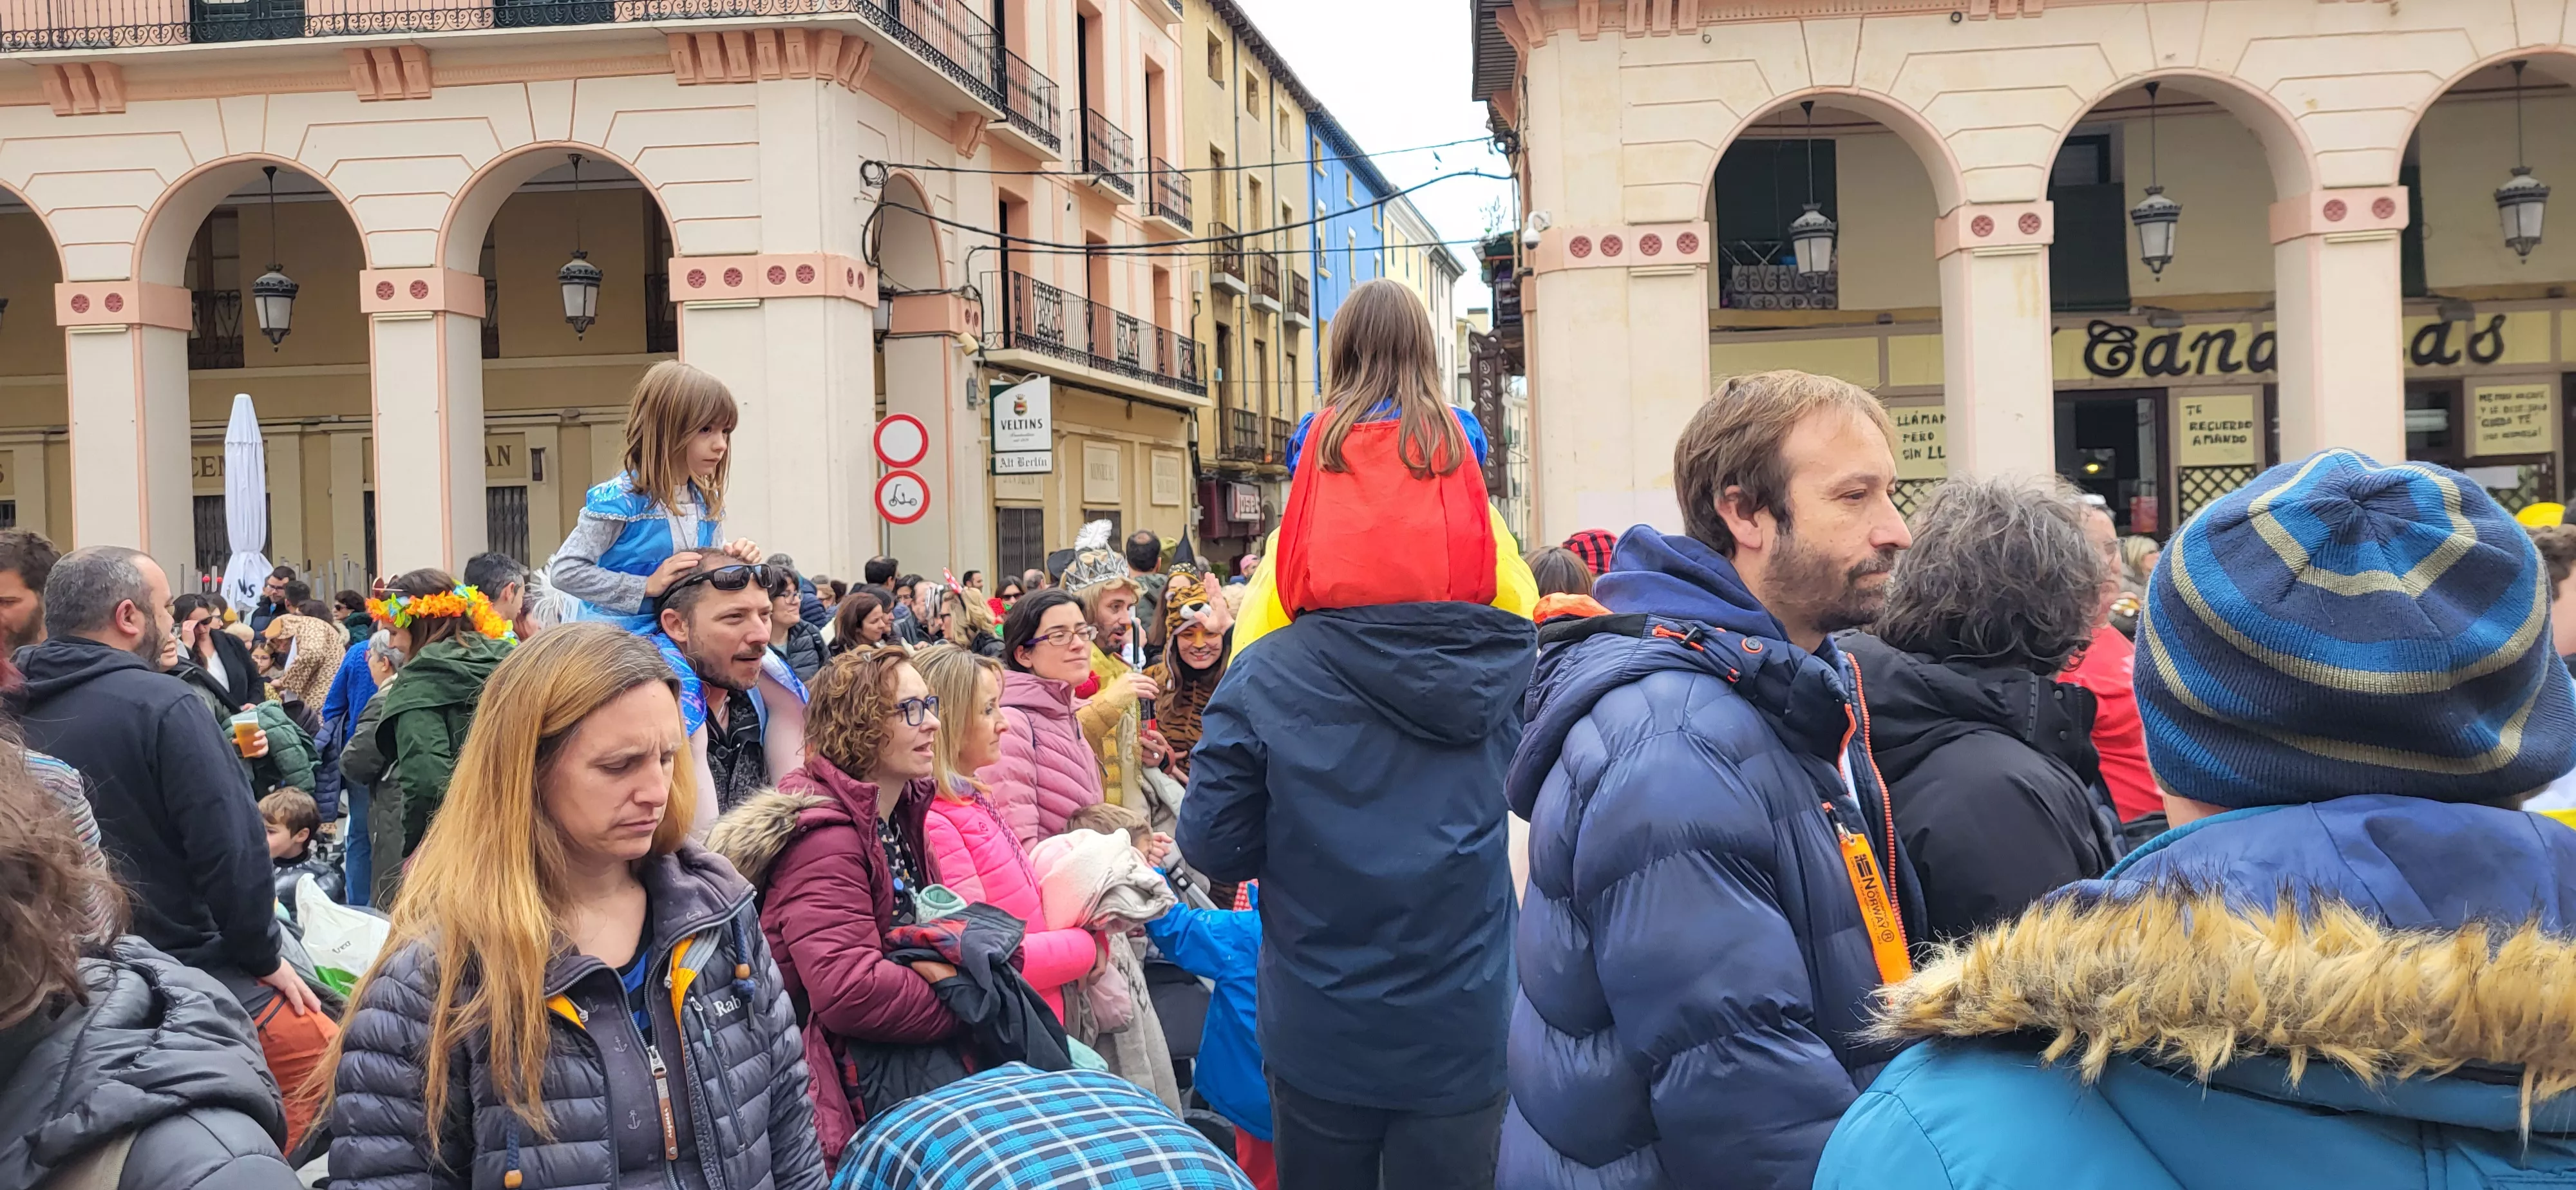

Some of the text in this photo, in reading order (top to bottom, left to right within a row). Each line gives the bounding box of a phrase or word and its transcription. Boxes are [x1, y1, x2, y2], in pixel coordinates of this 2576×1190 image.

[1001, 419, 1043, 430] VELTINS
[999, 456, 1048, 468] Alt Berlin
[1862, 877, 1890, 929] NORWAY
[713, 995, 741, 1017] Rab
